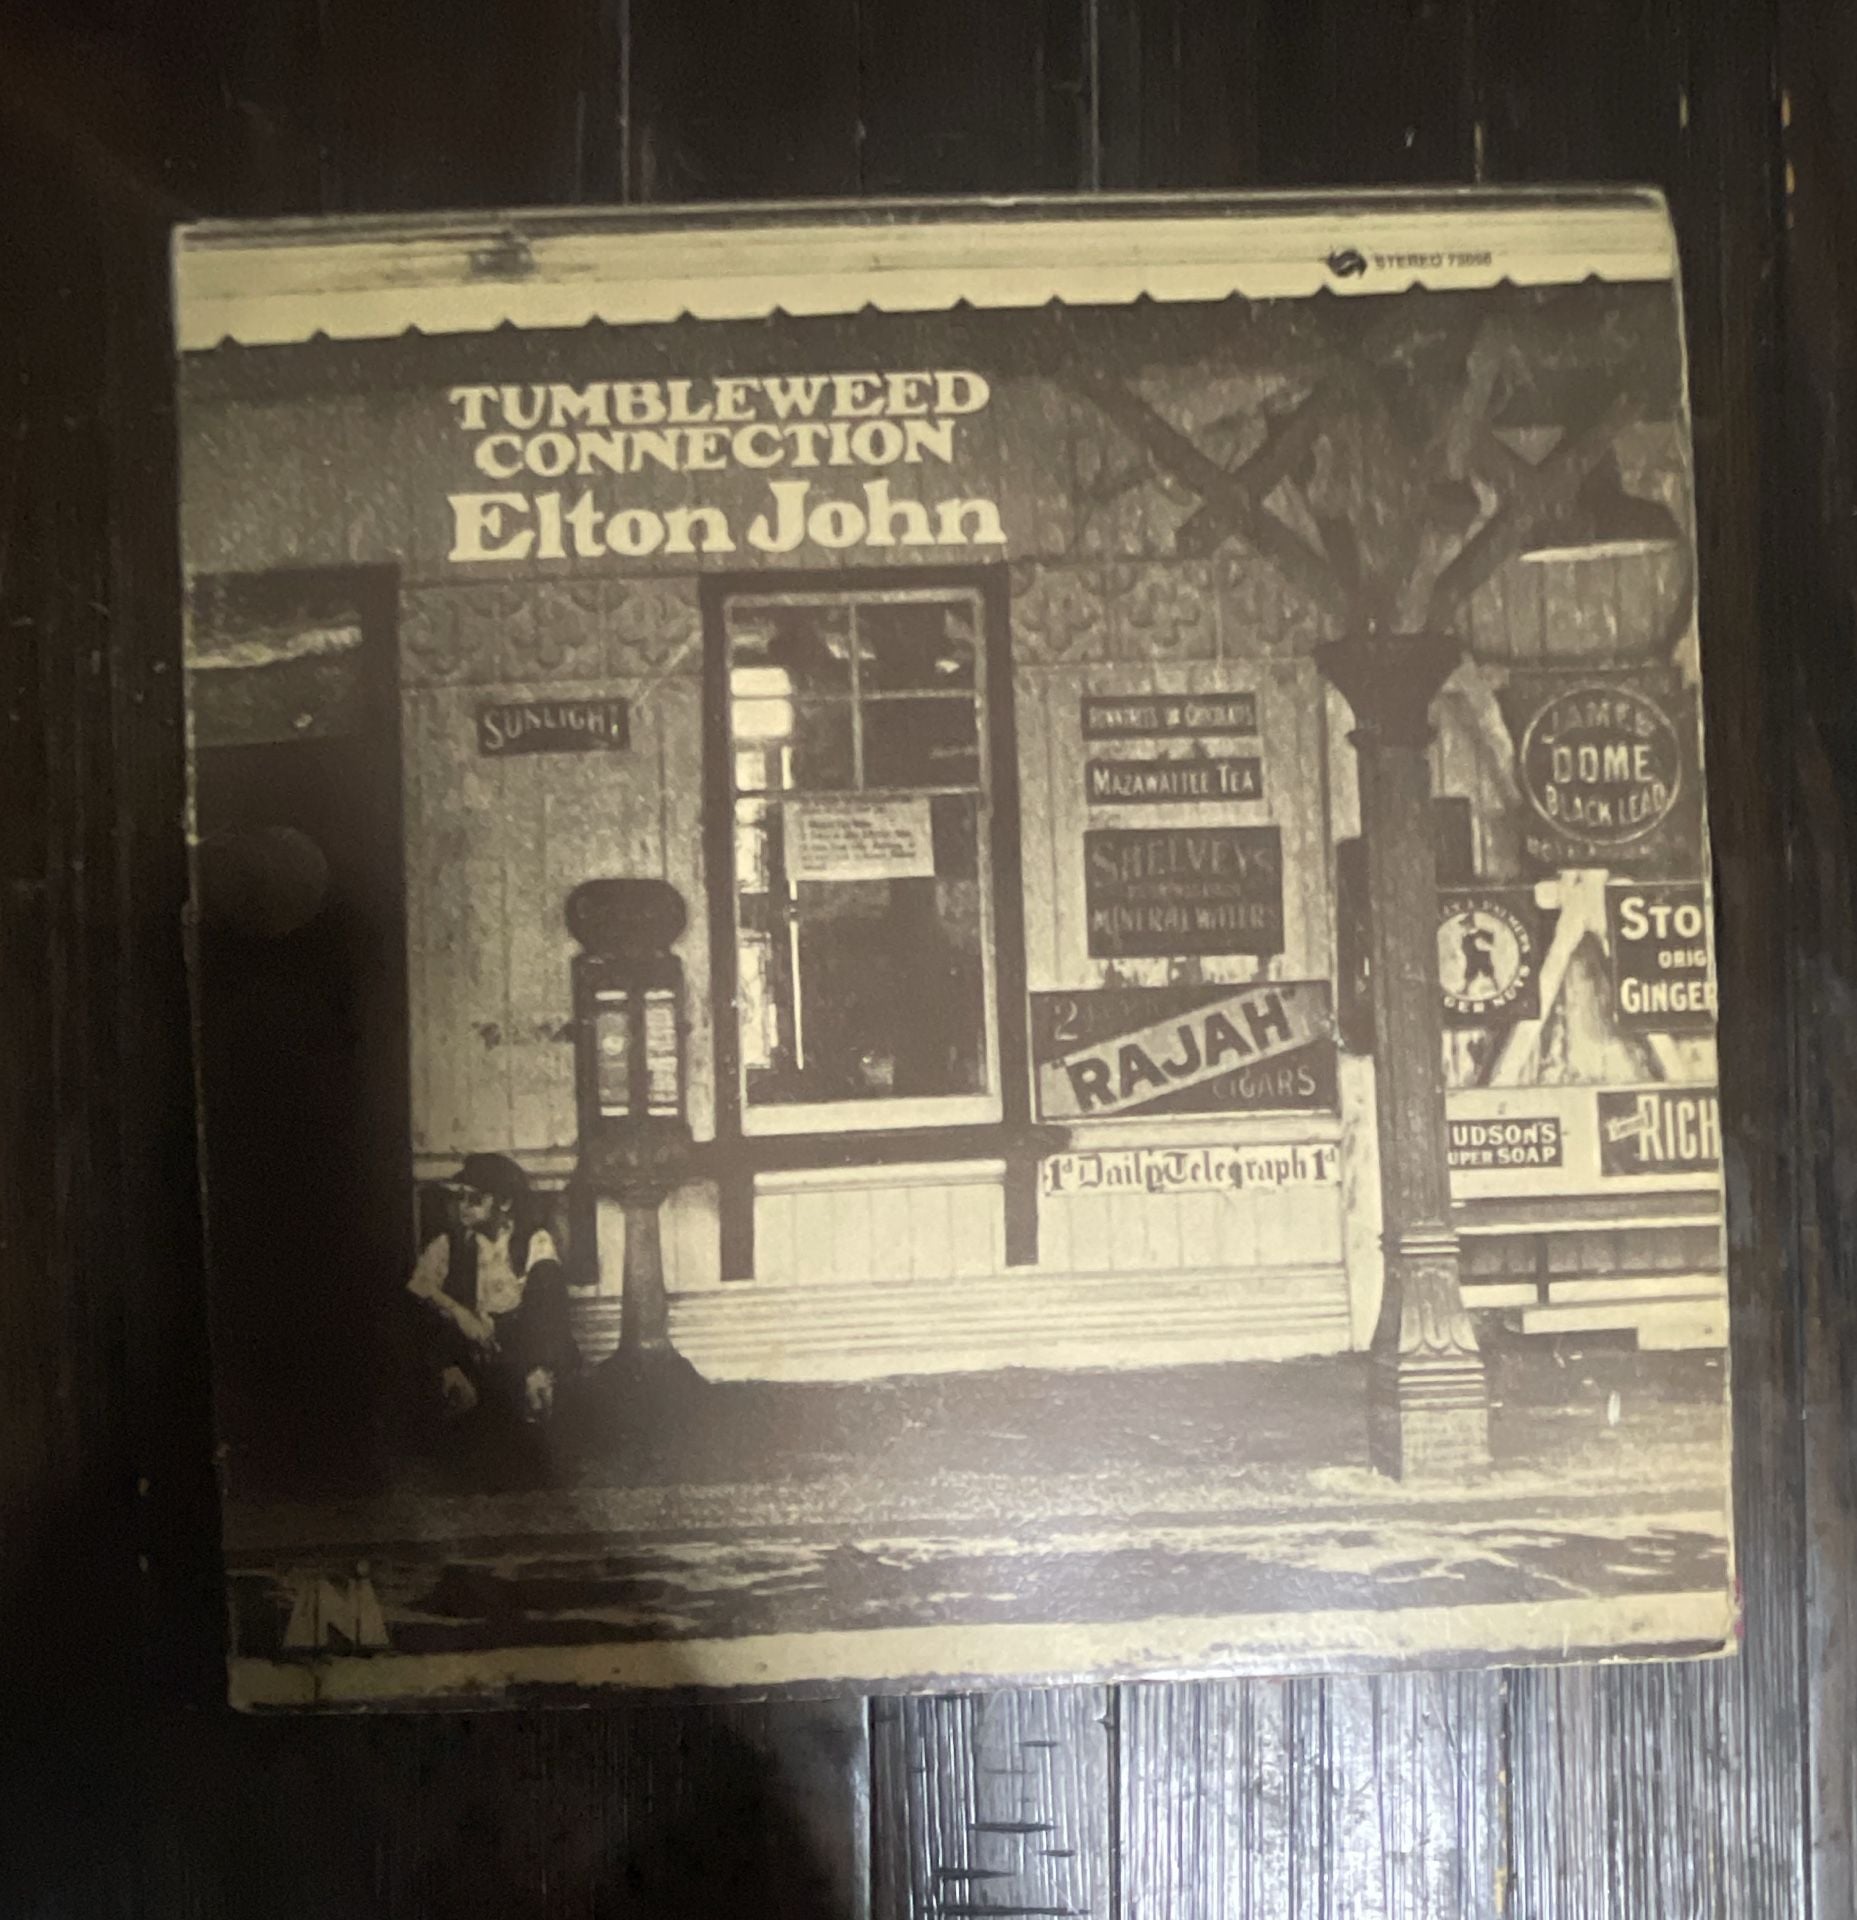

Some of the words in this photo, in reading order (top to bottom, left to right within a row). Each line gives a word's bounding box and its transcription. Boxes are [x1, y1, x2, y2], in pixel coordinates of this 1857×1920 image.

[448, 370, 991, 430] TUMBLEWEED
[475, 419, 956, 479] CONNECTION
[446, 489, 737, 563] Elton
[747, 478, 1008, 552] John
[1217, 763, 1255, 793] TEA
[1552, 742, 1655, 784] DOME
[1619, 896, 1703, 941] STO
[1658, 950, 1708, 970] ORIG
[1212, 1065, 1317, 1100] CIGARS
[1636, 1093, 1720, 1162] RICH
[1078, 1153, 1165, 1193] Daily
[1164, 1148, 1308, 1188] Telegraph
[1496, 1146, 1557, 1164] SOAP
